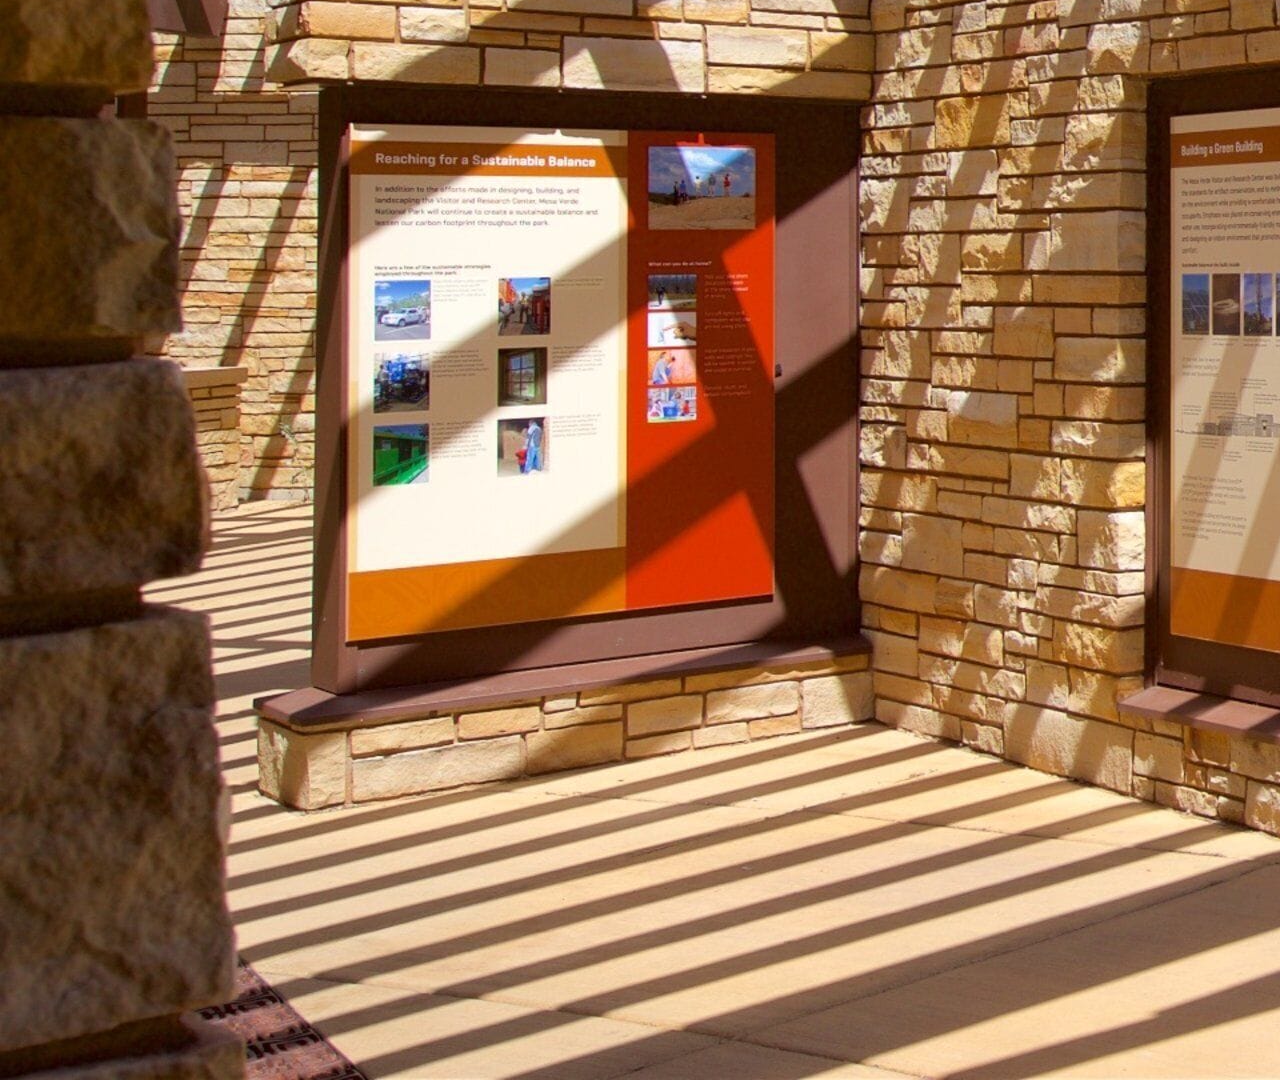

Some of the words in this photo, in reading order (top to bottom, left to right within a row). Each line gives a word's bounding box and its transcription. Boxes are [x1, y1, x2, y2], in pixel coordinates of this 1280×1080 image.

[1181, 144, 1208, 157] Building
[1209, 146, 1213, 154] a
[1214, 143, 1234, 154] Green
[1235, 140, 1264, 154] Building
[375, 152, 436, 167] Reaching
[439, 154, 458, 165] for
[461, 156, 469, 165] a
[472, 154, 546, 166] Sustainable
[548, 155, 596, 167] Balance
